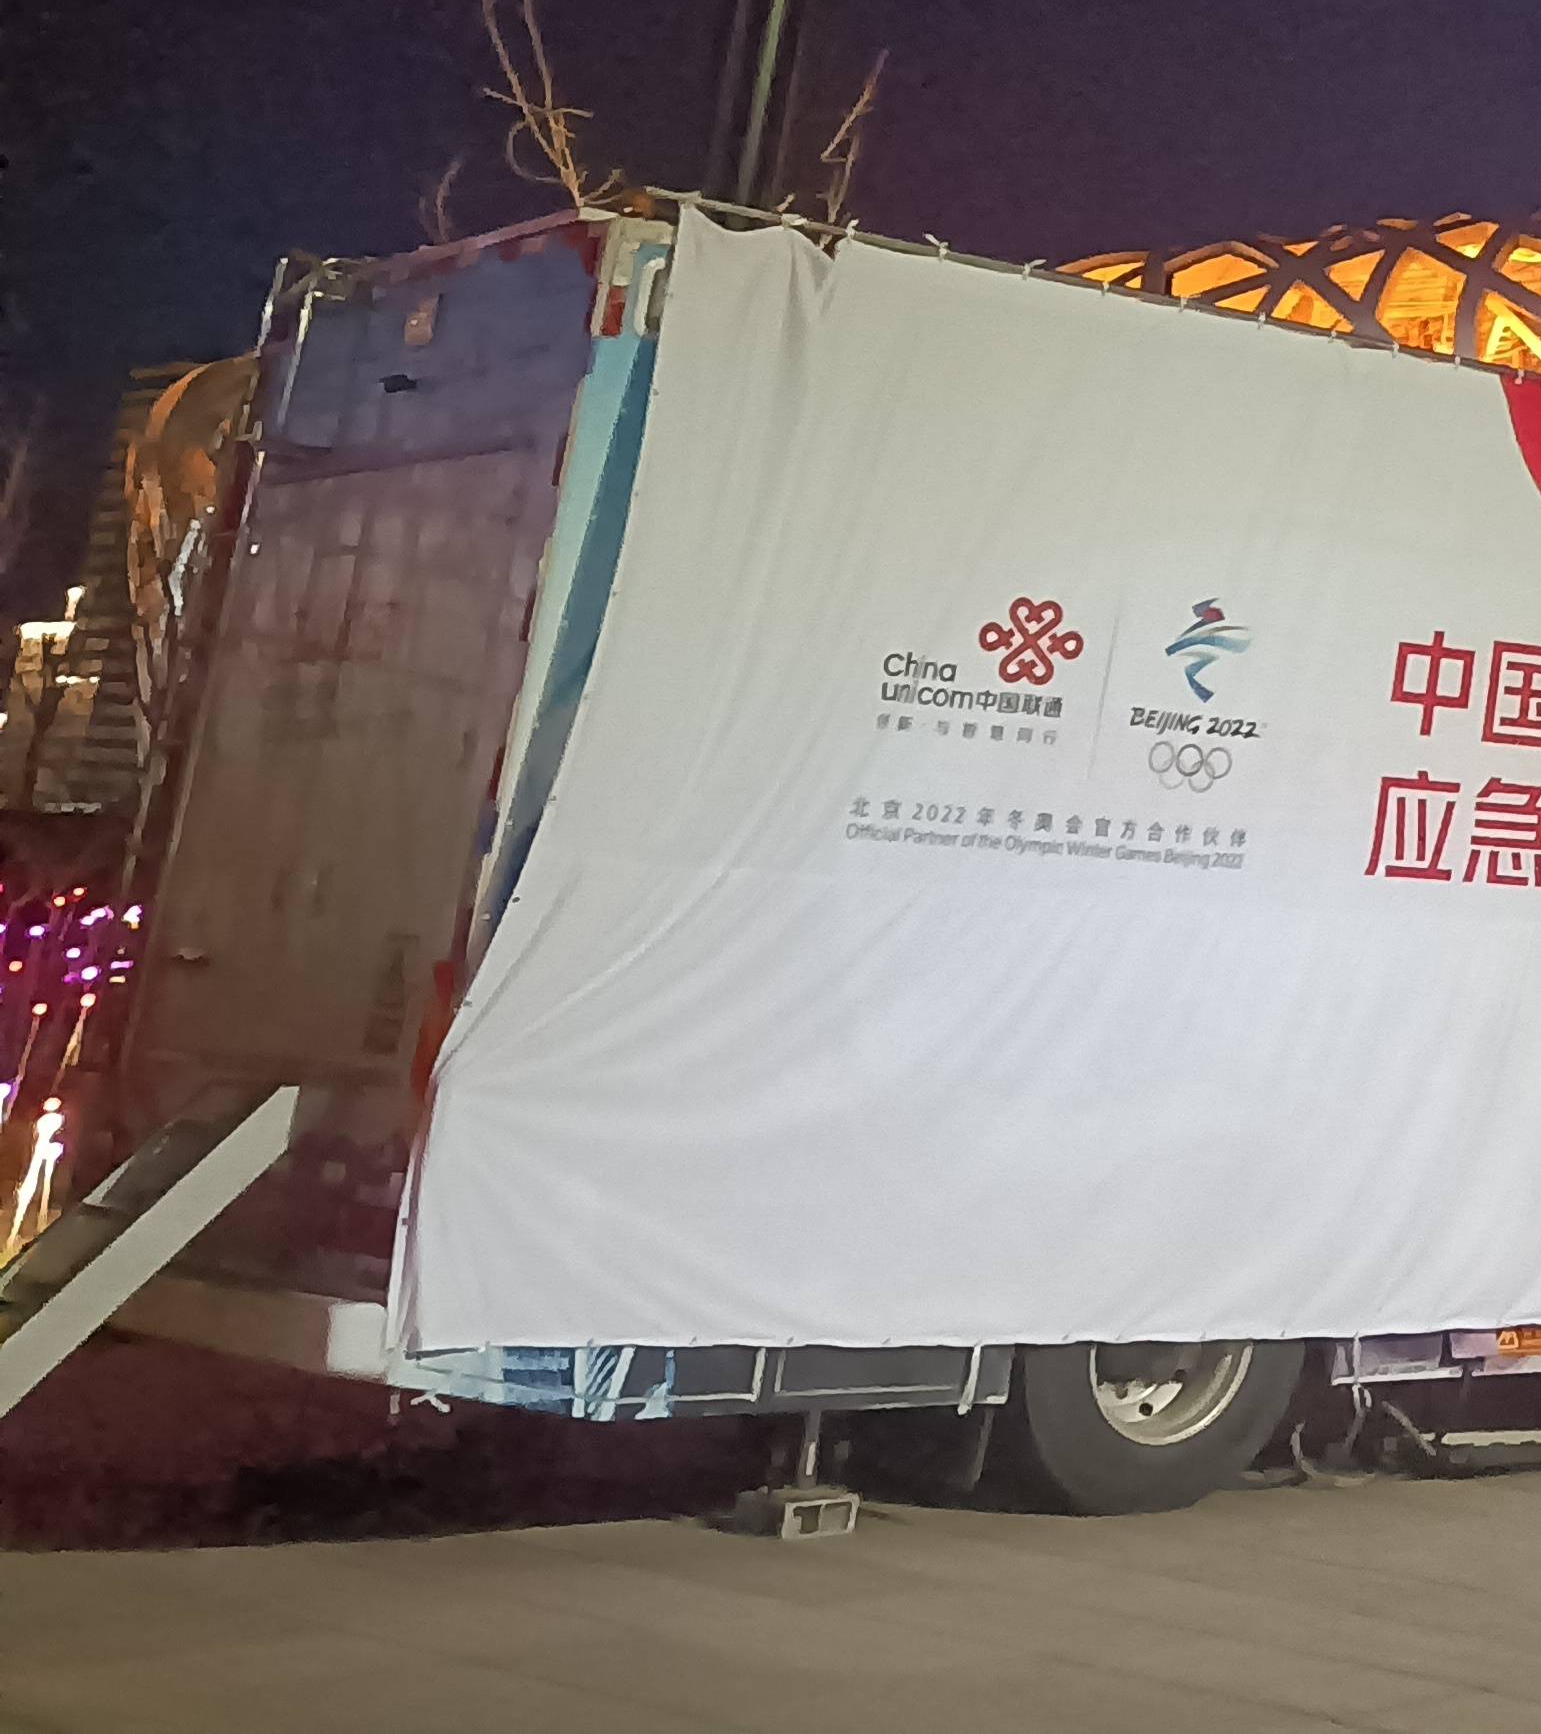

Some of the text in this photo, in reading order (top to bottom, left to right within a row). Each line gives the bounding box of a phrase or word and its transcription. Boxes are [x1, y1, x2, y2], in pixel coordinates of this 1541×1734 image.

[883, 652, 957, 682] China
[1129, 707, 1261, 738] BEIJING 2022
